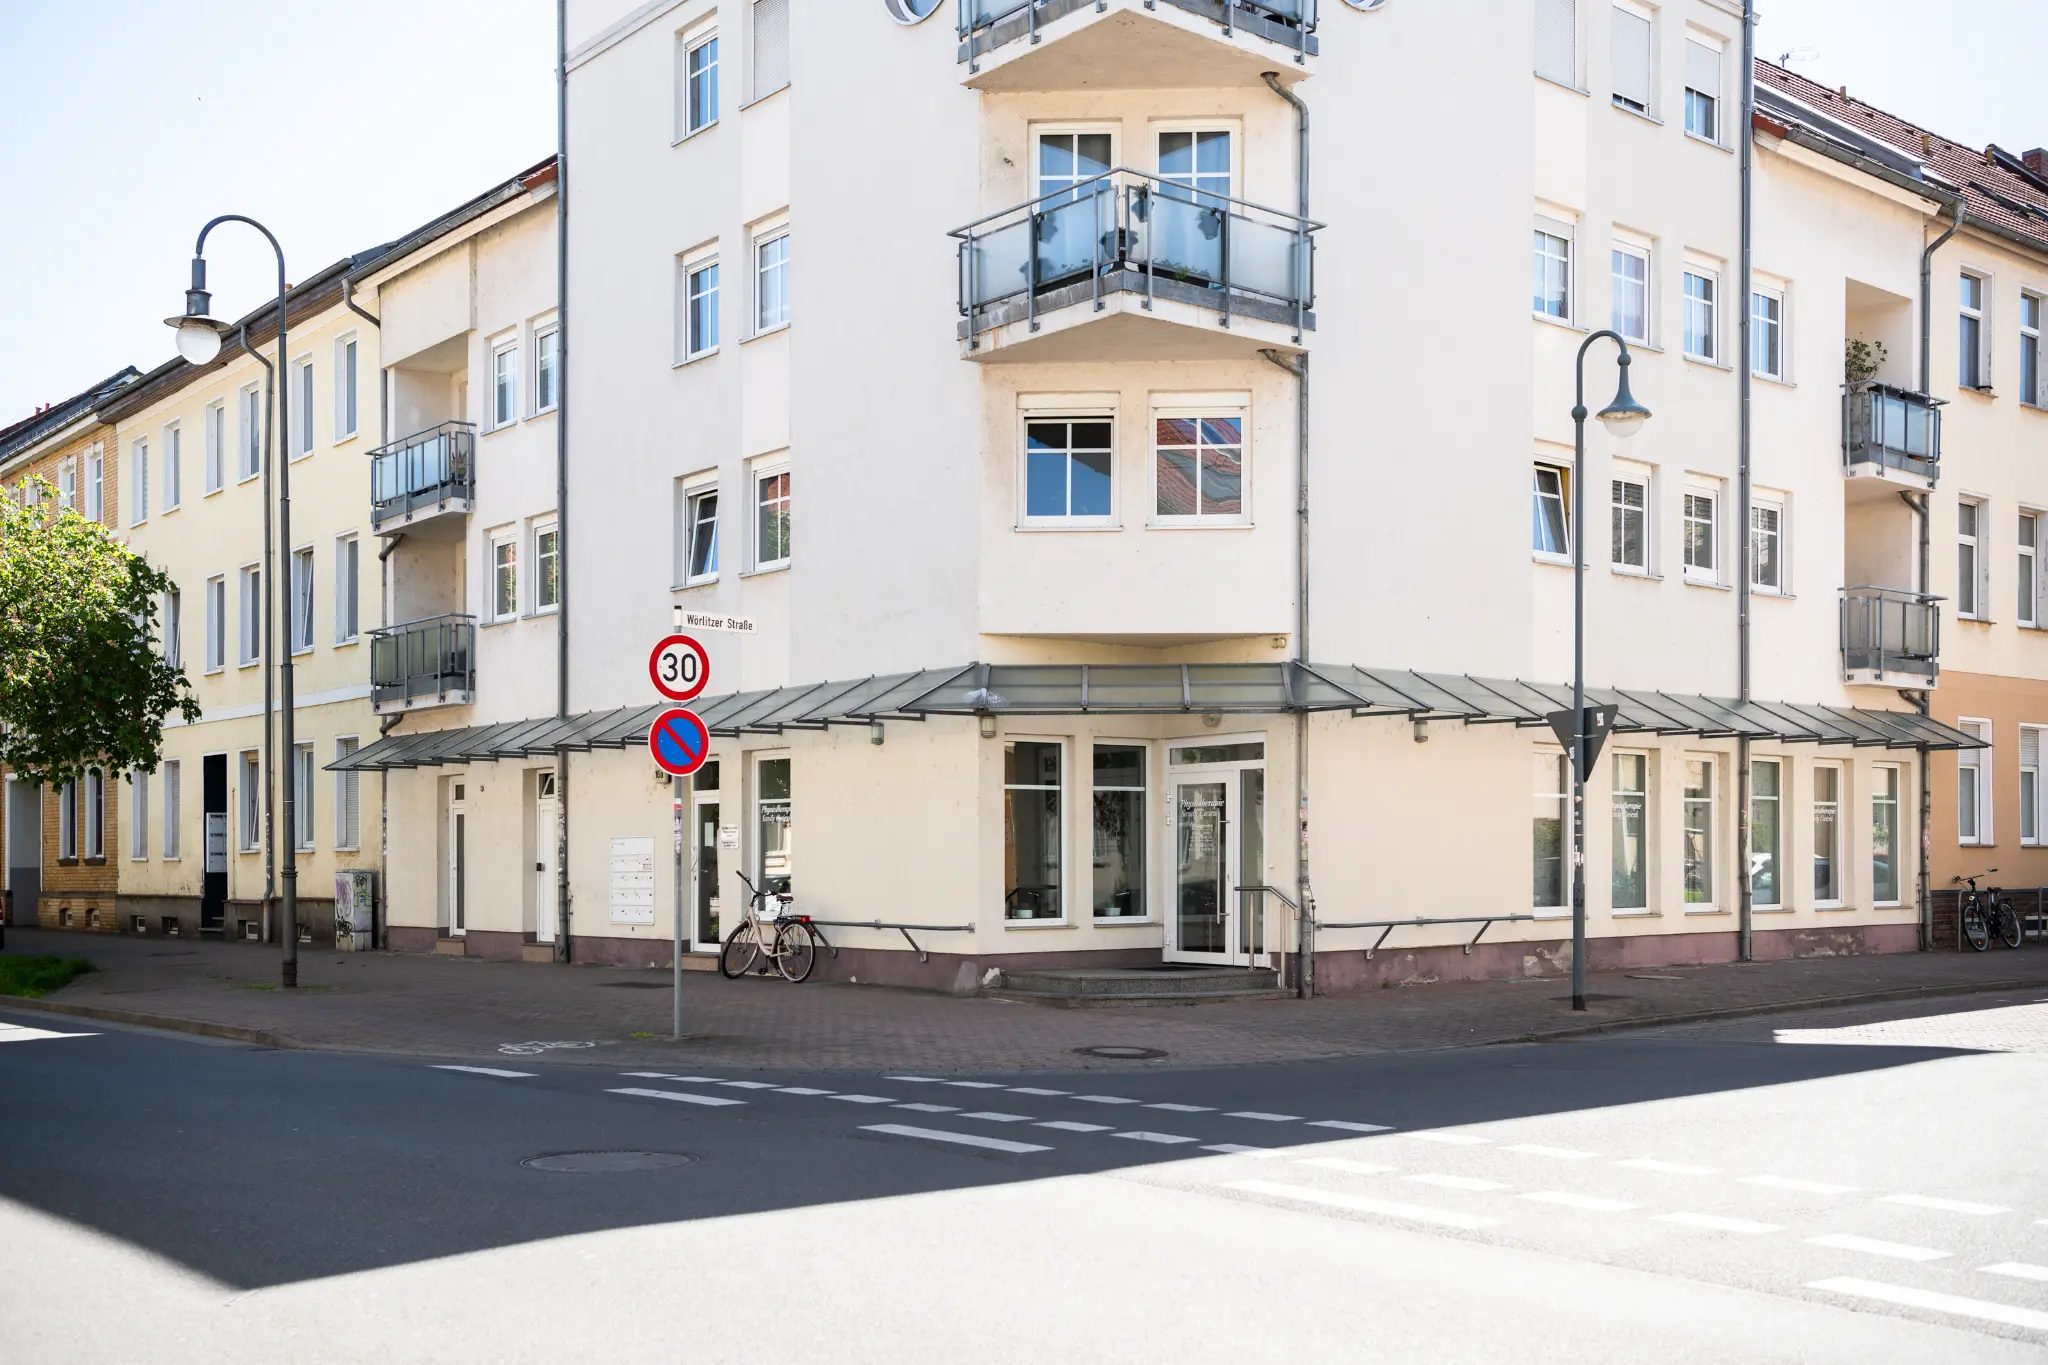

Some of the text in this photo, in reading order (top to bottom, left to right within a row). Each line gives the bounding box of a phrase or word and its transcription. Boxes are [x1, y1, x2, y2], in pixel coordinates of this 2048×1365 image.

[687, 614, 753, 631] Wörlitzer Straße
[662, 652, 697, 682] 30
